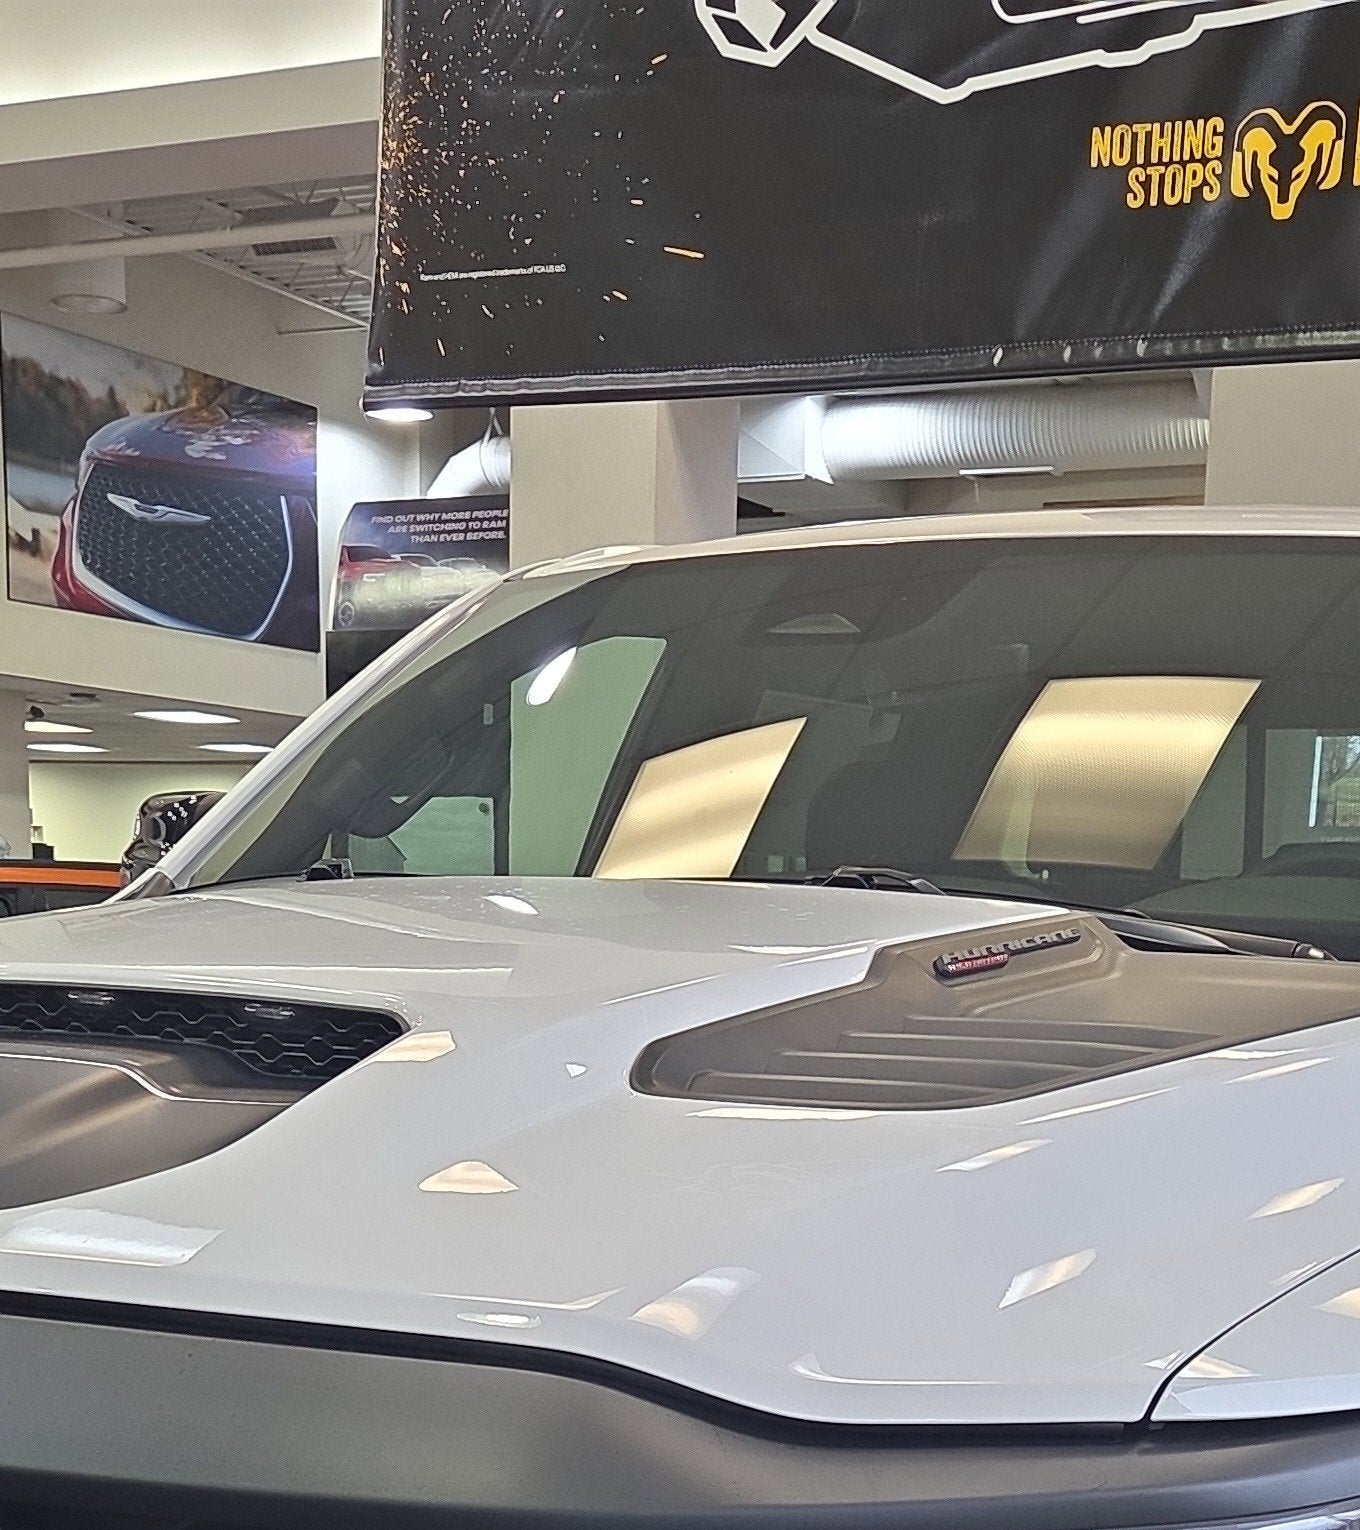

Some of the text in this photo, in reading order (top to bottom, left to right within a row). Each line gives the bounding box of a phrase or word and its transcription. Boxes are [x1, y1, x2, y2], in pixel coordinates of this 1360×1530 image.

[1089, 116, 1225, 168] NOTHING
[1126, 159, 1224, 209] STOPS
[371, 509, 509, 524] FIND OUT WHY MORE PEOPLE
[387, 520, 506, 534] ARE SWITCHING TO RAM
[410, 534, 438, 544] THAN
[439, 532, 465, 542] EVER
